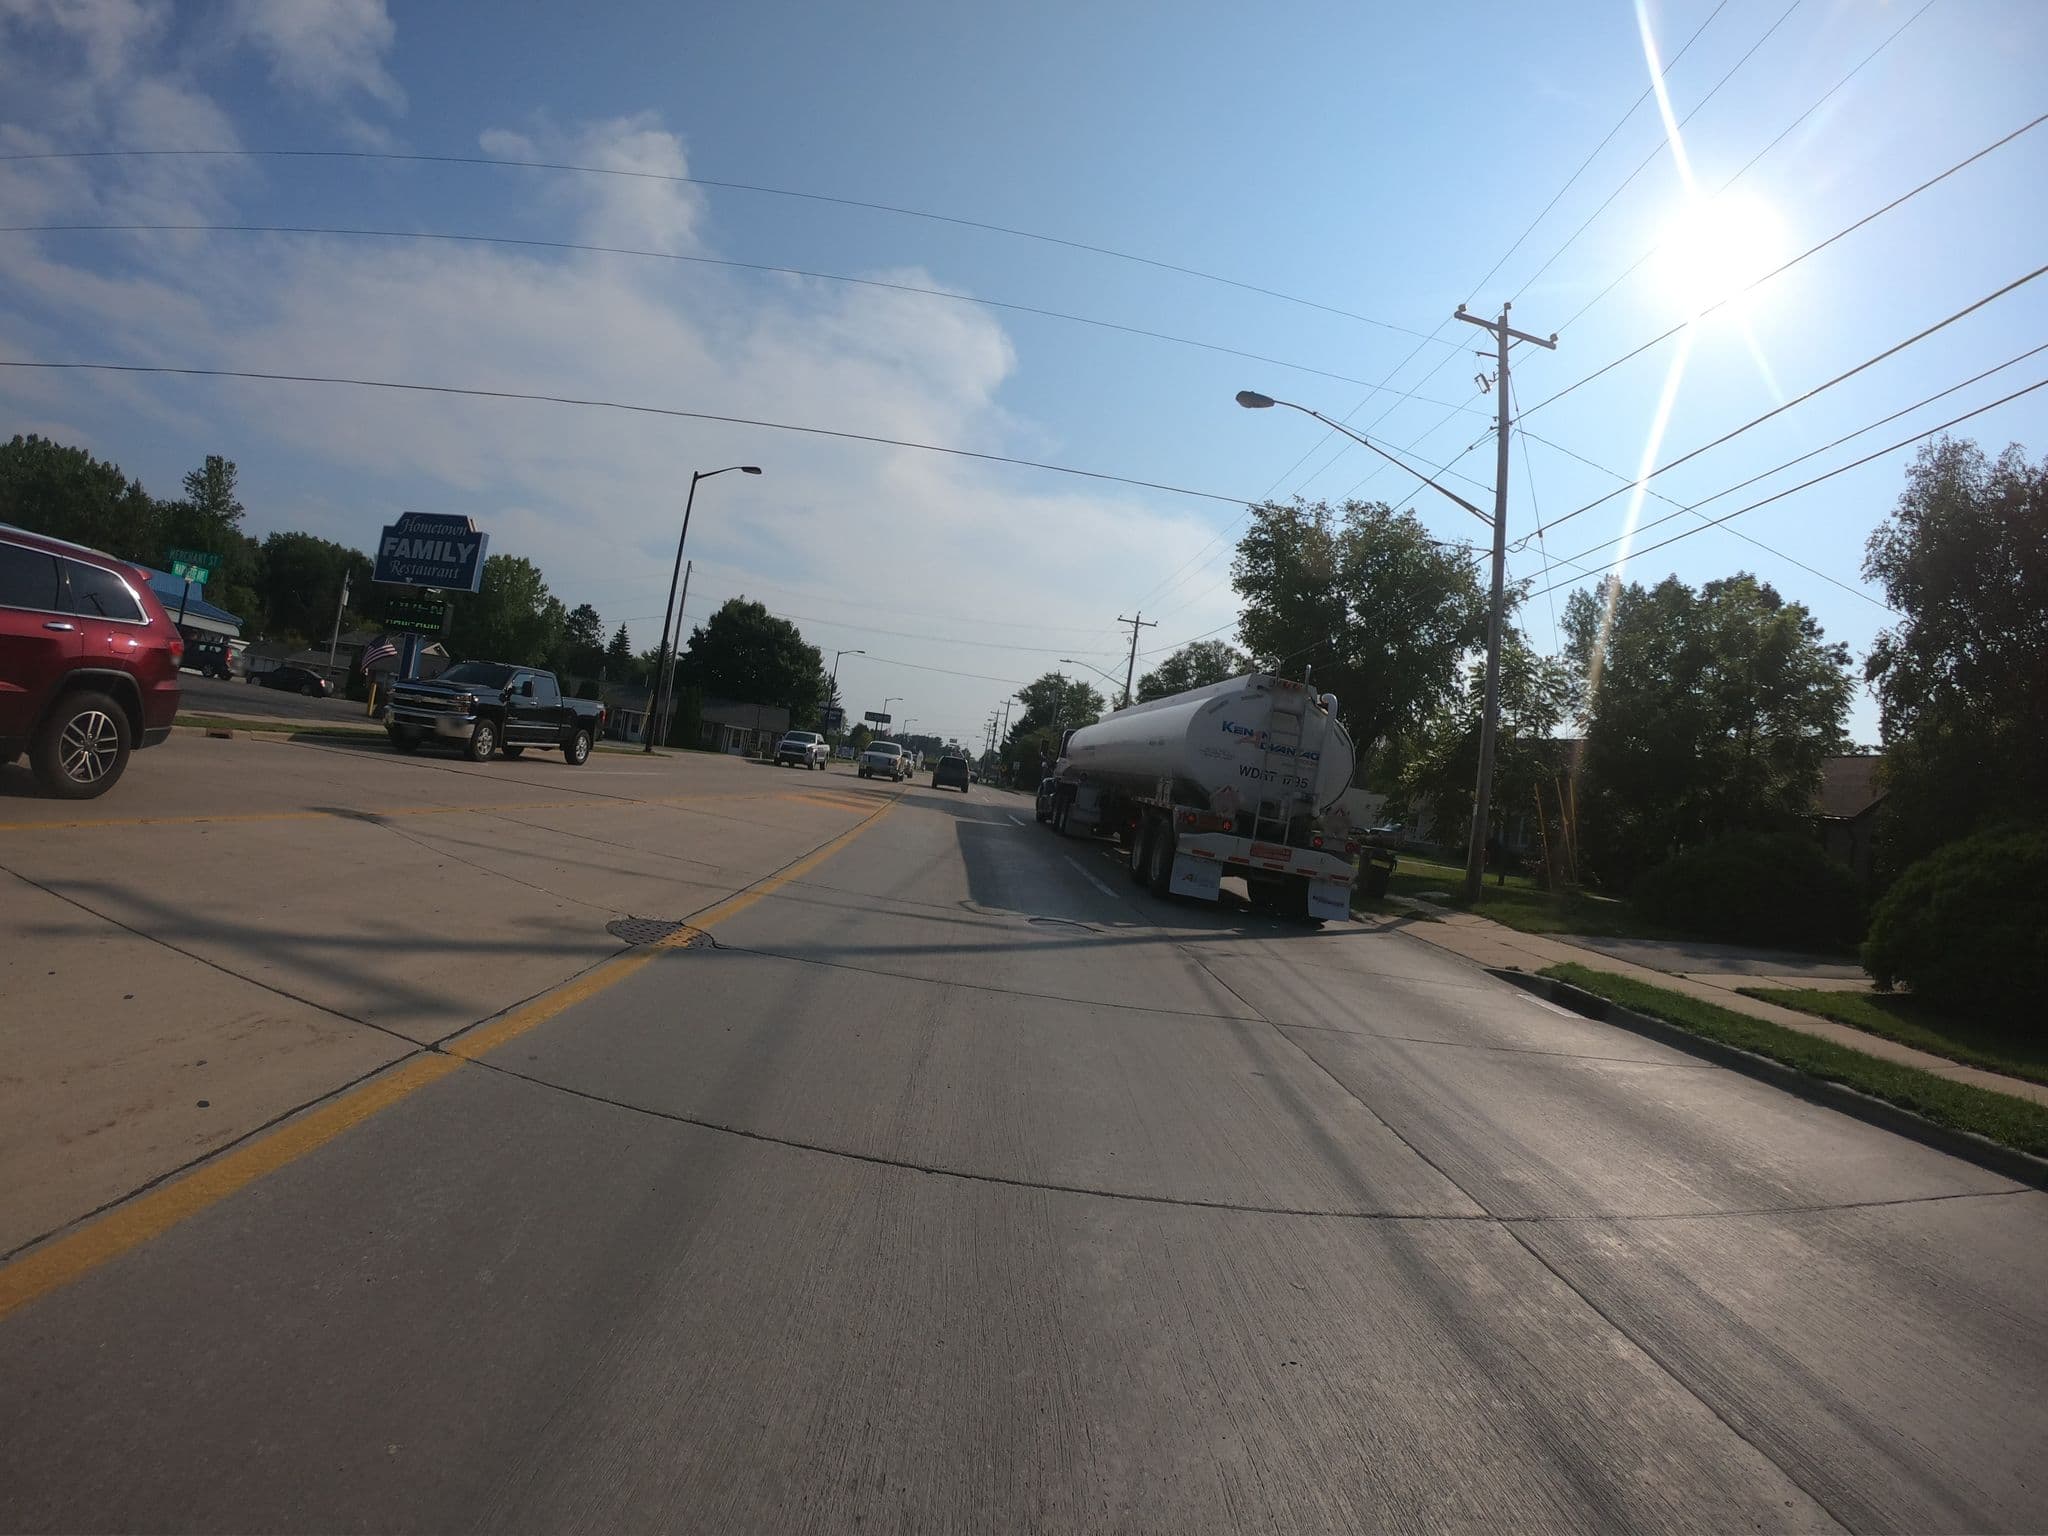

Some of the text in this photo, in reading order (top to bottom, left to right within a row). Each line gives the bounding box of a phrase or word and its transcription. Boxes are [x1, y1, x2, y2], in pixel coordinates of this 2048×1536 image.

[399, 518, 467, 536] Hometown
[382, 537, 476, 563] FAMILY
[390, 560, 460, 579] Restaurant
